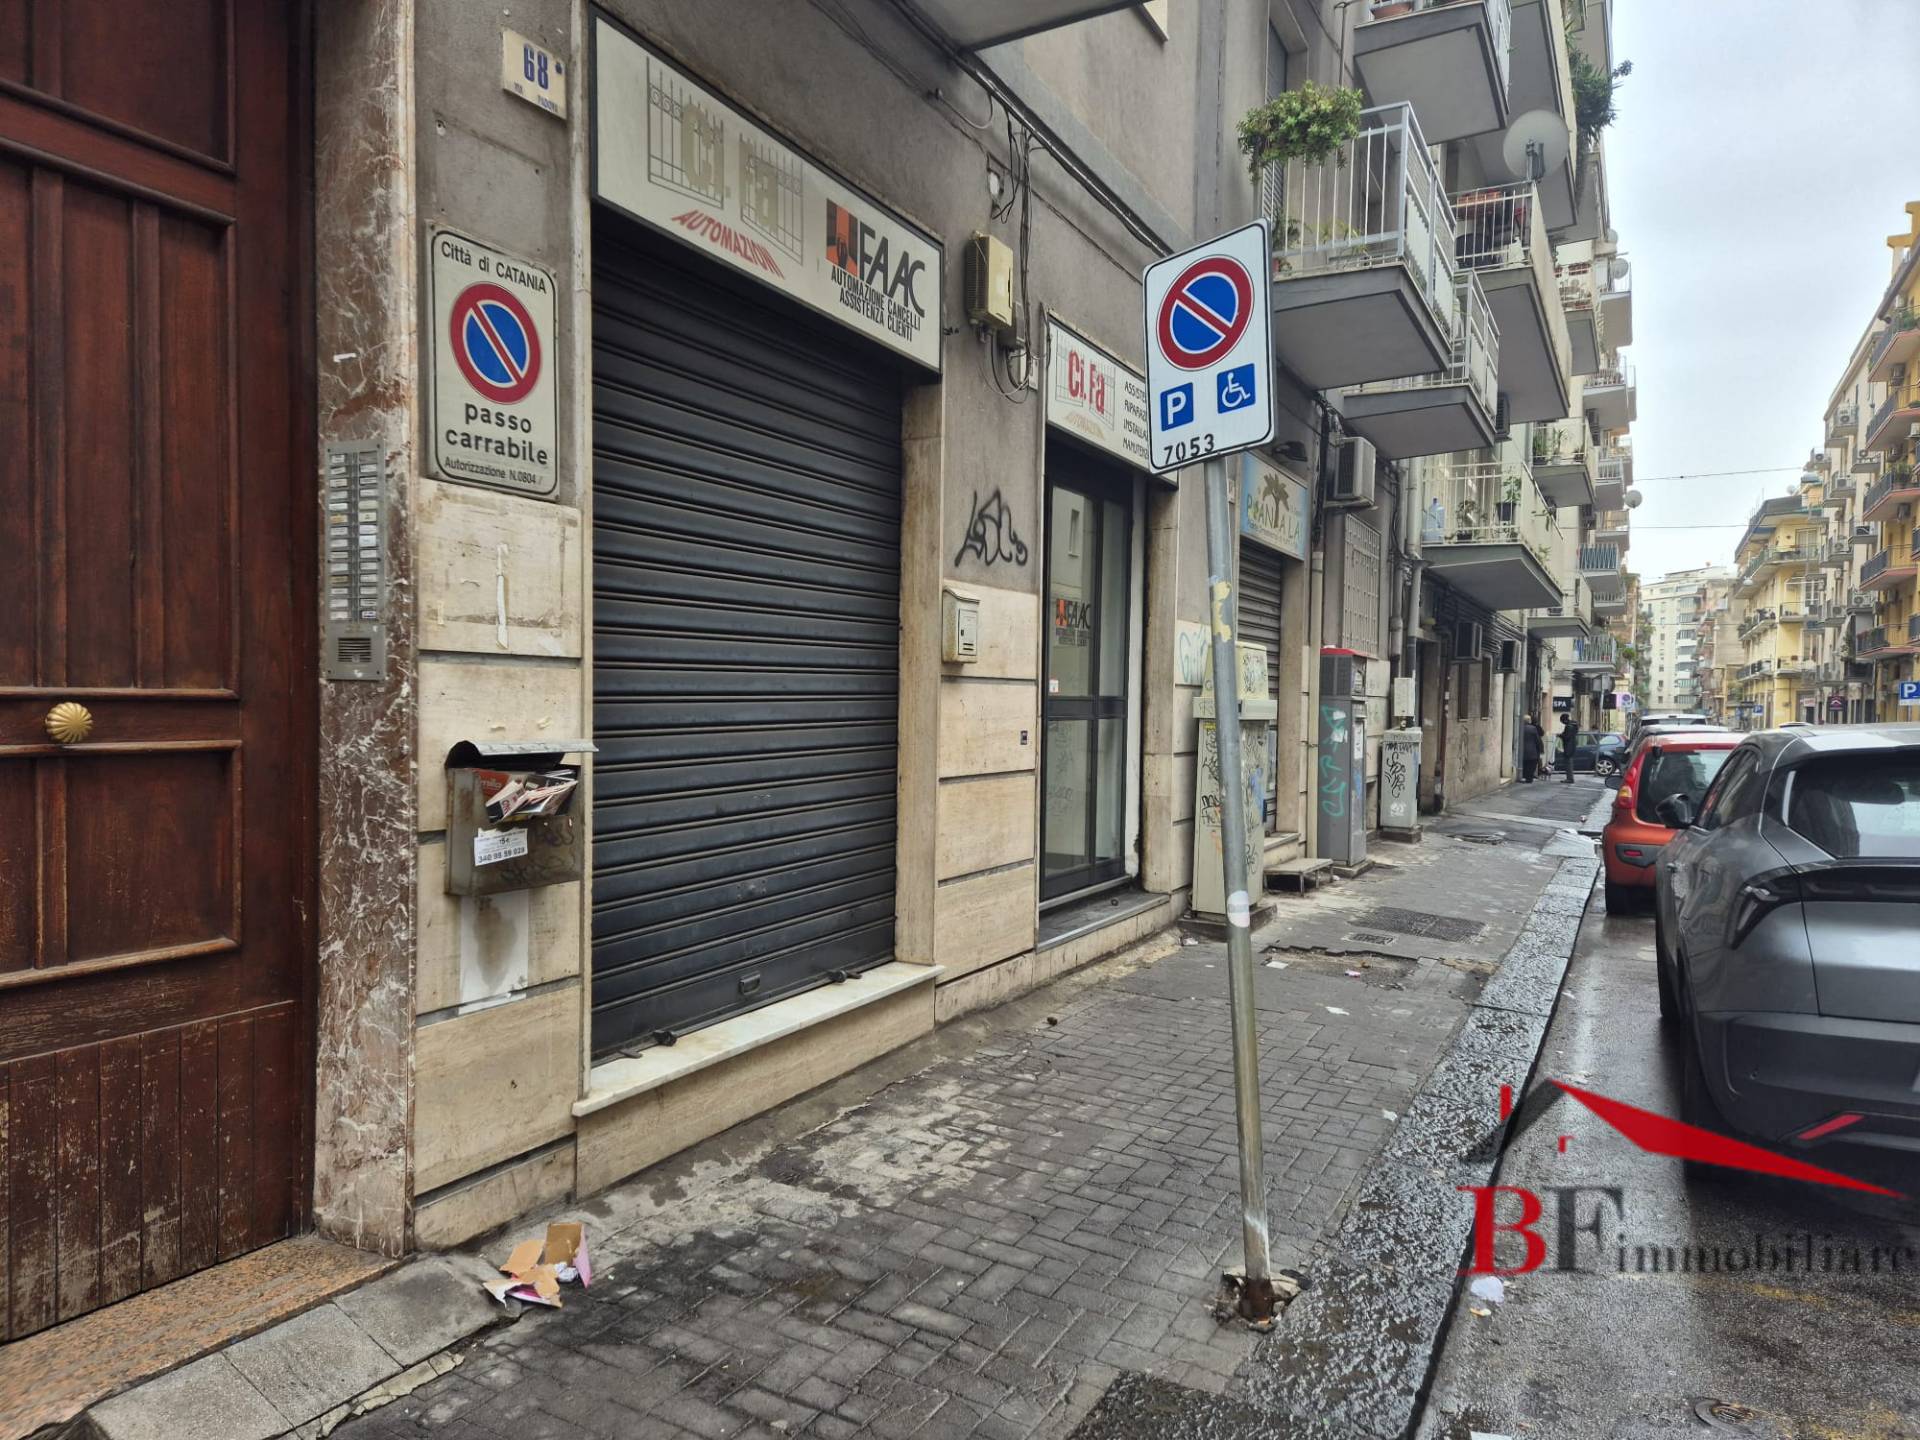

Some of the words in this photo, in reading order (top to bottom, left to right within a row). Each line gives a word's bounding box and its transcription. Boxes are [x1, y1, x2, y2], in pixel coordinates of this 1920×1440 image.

[523, 43, 549, 90] 68
[671, 208, 786, 281] AUTOMAZIONI
[441, 241, 472, 266] Città
[478, 257, 490, 273] di
[496, 262, 547, 294] CATANIA
[859, 219, 926, 319] FAAC
[831, 264, 885, 311] AUTOMAZIONE
[887, 298, 921, 332] CANCELLI
[839, 287, 885, 327] ASSISTENZA
[887, 315, 913, 342] CLIENTI
[464, 403, 532, 433] passo
[1167, 390, 1187, 425] P
[444, 456, 506, 479] Autorizzazione
[445, 429, 548, 465] carrabile
[1164, 433, 1215, 465] 7053
[1903, 683, 1917, 698] P
